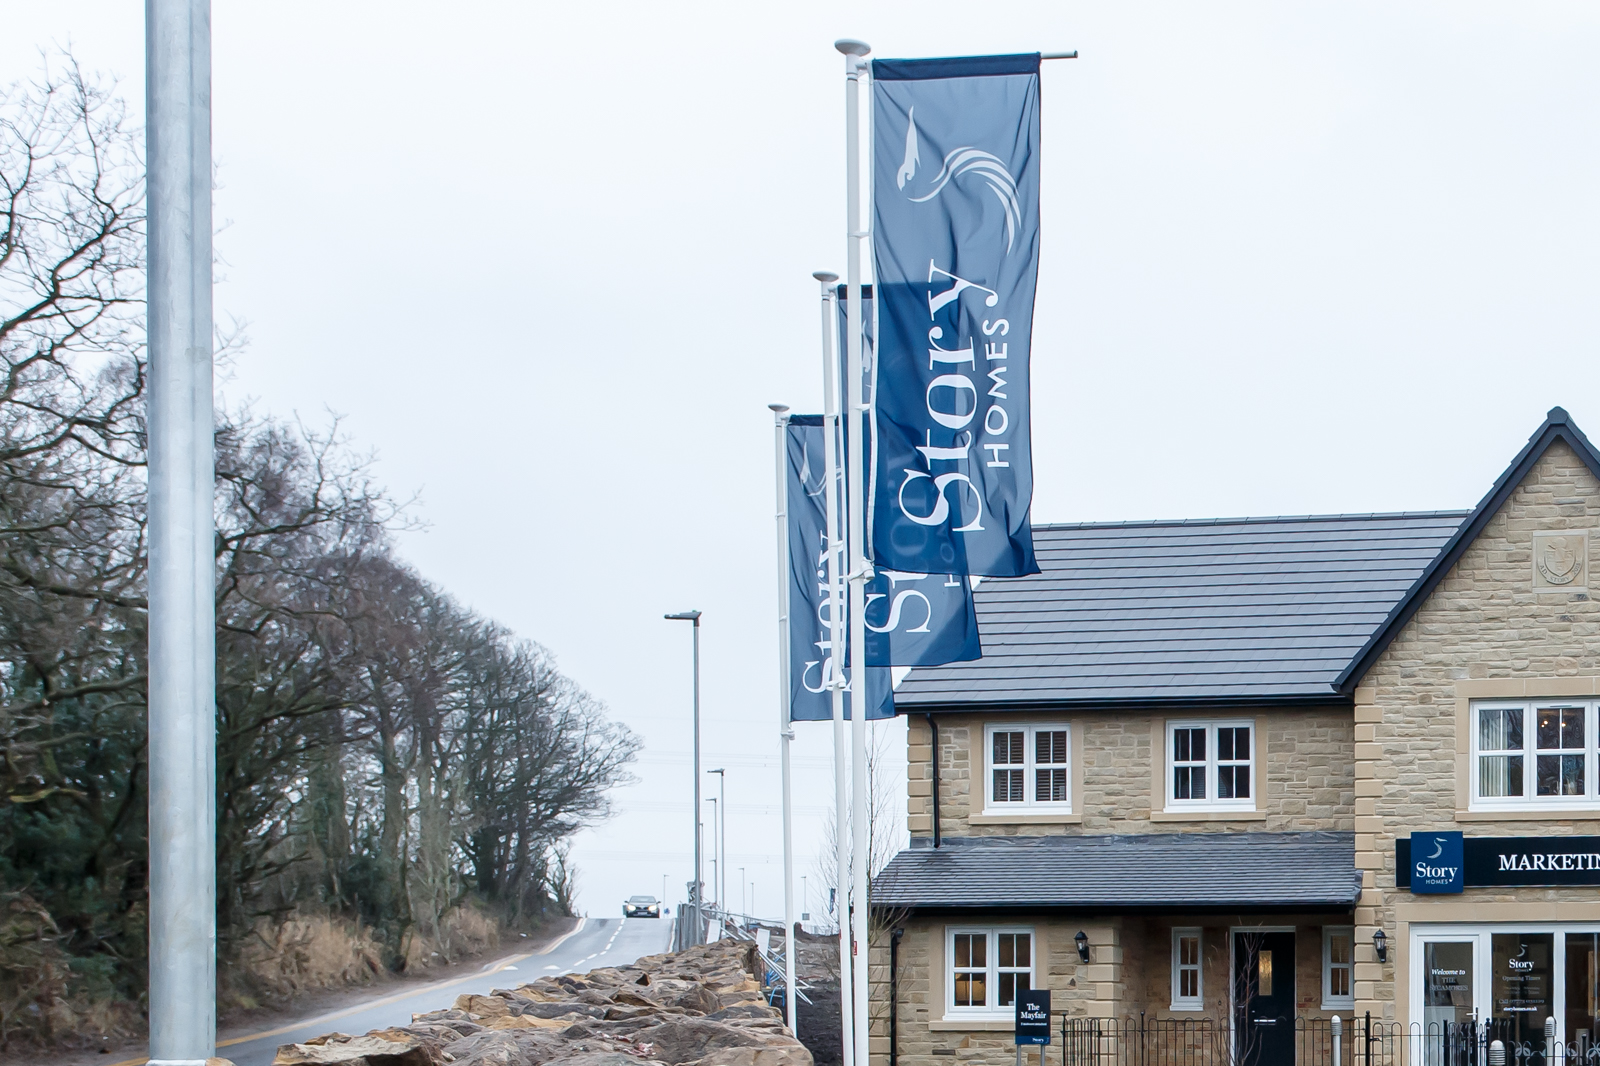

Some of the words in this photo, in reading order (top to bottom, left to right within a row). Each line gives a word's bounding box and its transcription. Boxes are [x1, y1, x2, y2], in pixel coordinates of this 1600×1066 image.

[899, 258, 998, 532] Story
[982, 318, 1010, 468] HOMES
[1416, 861, 1458, 882] Story
[1508, 958, 1534, 971] Story
[1020, 1011, 1047, 1020] Mayfair
[1026, 1003, 1040, 1011] The
